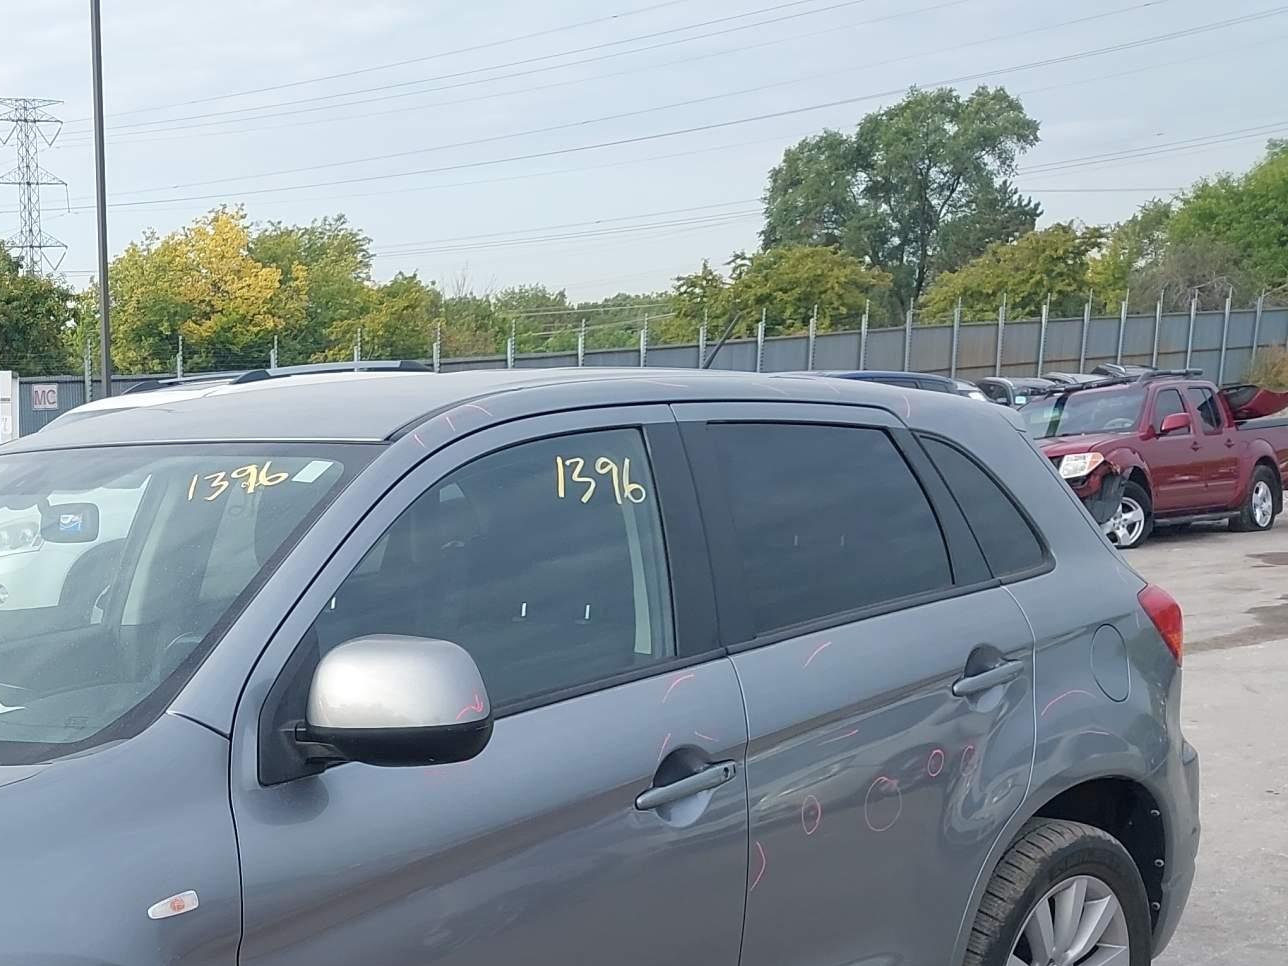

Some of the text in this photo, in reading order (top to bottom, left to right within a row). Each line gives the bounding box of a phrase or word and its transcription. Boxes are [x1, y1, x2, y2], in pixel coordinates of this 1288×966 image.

[34, 389, 57, 406] MC
[188, 460, 289, 501] 1396
[556, 455, 646, 505] 1396
